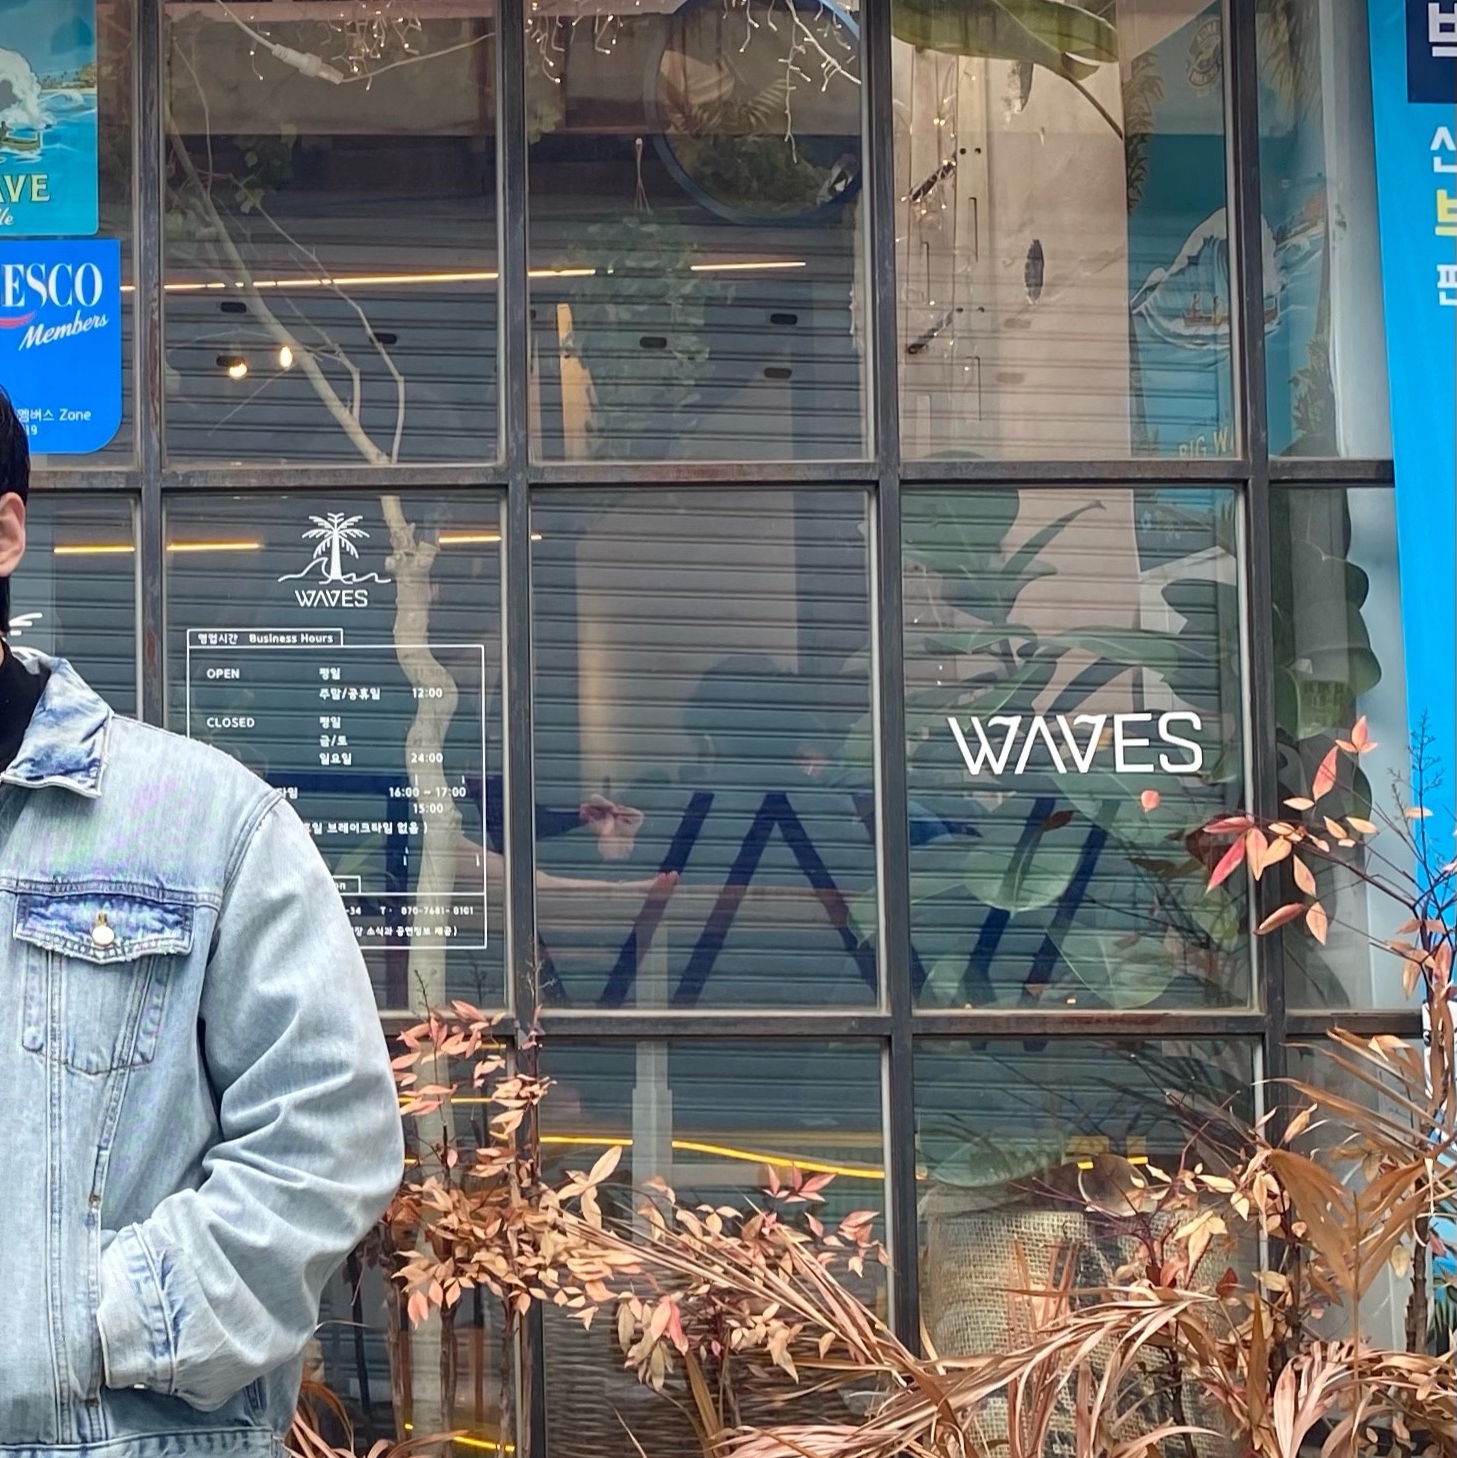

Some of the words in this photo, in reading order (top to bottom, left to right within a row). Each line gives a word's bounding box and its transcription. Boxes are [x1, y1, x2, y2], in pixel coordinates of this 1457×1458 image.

[19, 309, 110, 352] Members
[59, 408, 91, 421] Zone
[294, 589, 369, 608] WAVES
[197, 633, 239, 645] 영업시간
[249, 633, 298, 643] Business
[300, 633, 334, 643] Hours
[206, 668, 241, 679] OPEN
[319, 667, 341, 680] 평일
[319, 687, 381, 700] 주말/공휴일
[412, 687, 443, 699] 12:00
[206, 717, 255, 728] CLOSED
[319, 716, 341, 729] 평일
[947, 711, 1203, 776] WAVES
[319, 752, 352, 765] 일요일
[411, 752, 444, 764] 24:00
[389, 786, 420, 798] 16:00
[435, 786, 467, 798] 17:00
[413, 802, 444, 814] 15:00
